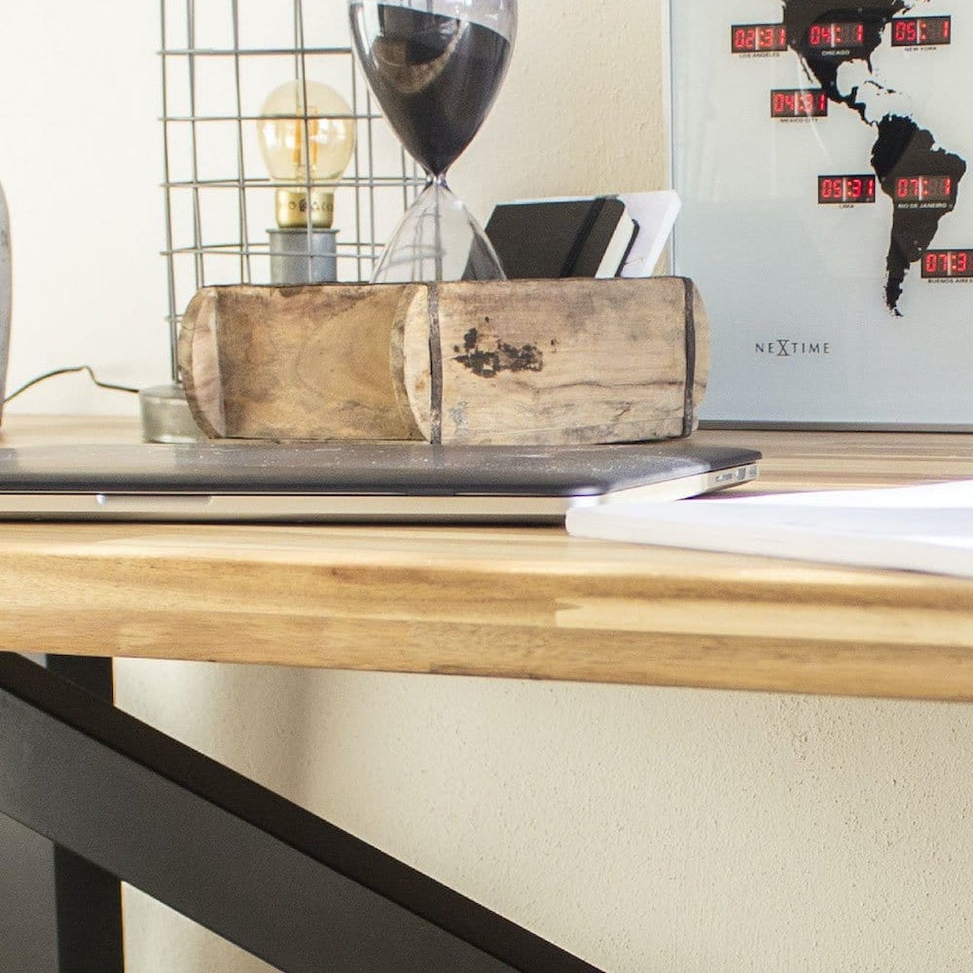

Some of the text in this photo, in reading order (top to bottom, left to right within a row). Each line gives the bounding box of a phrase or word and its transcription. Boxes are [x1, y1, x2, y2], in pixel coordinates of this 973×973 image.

[735, 28, 786, 49] 02:31
[821, 178, 874, 198] 05:31
[754, 339, 831, 357] NEXTIME
